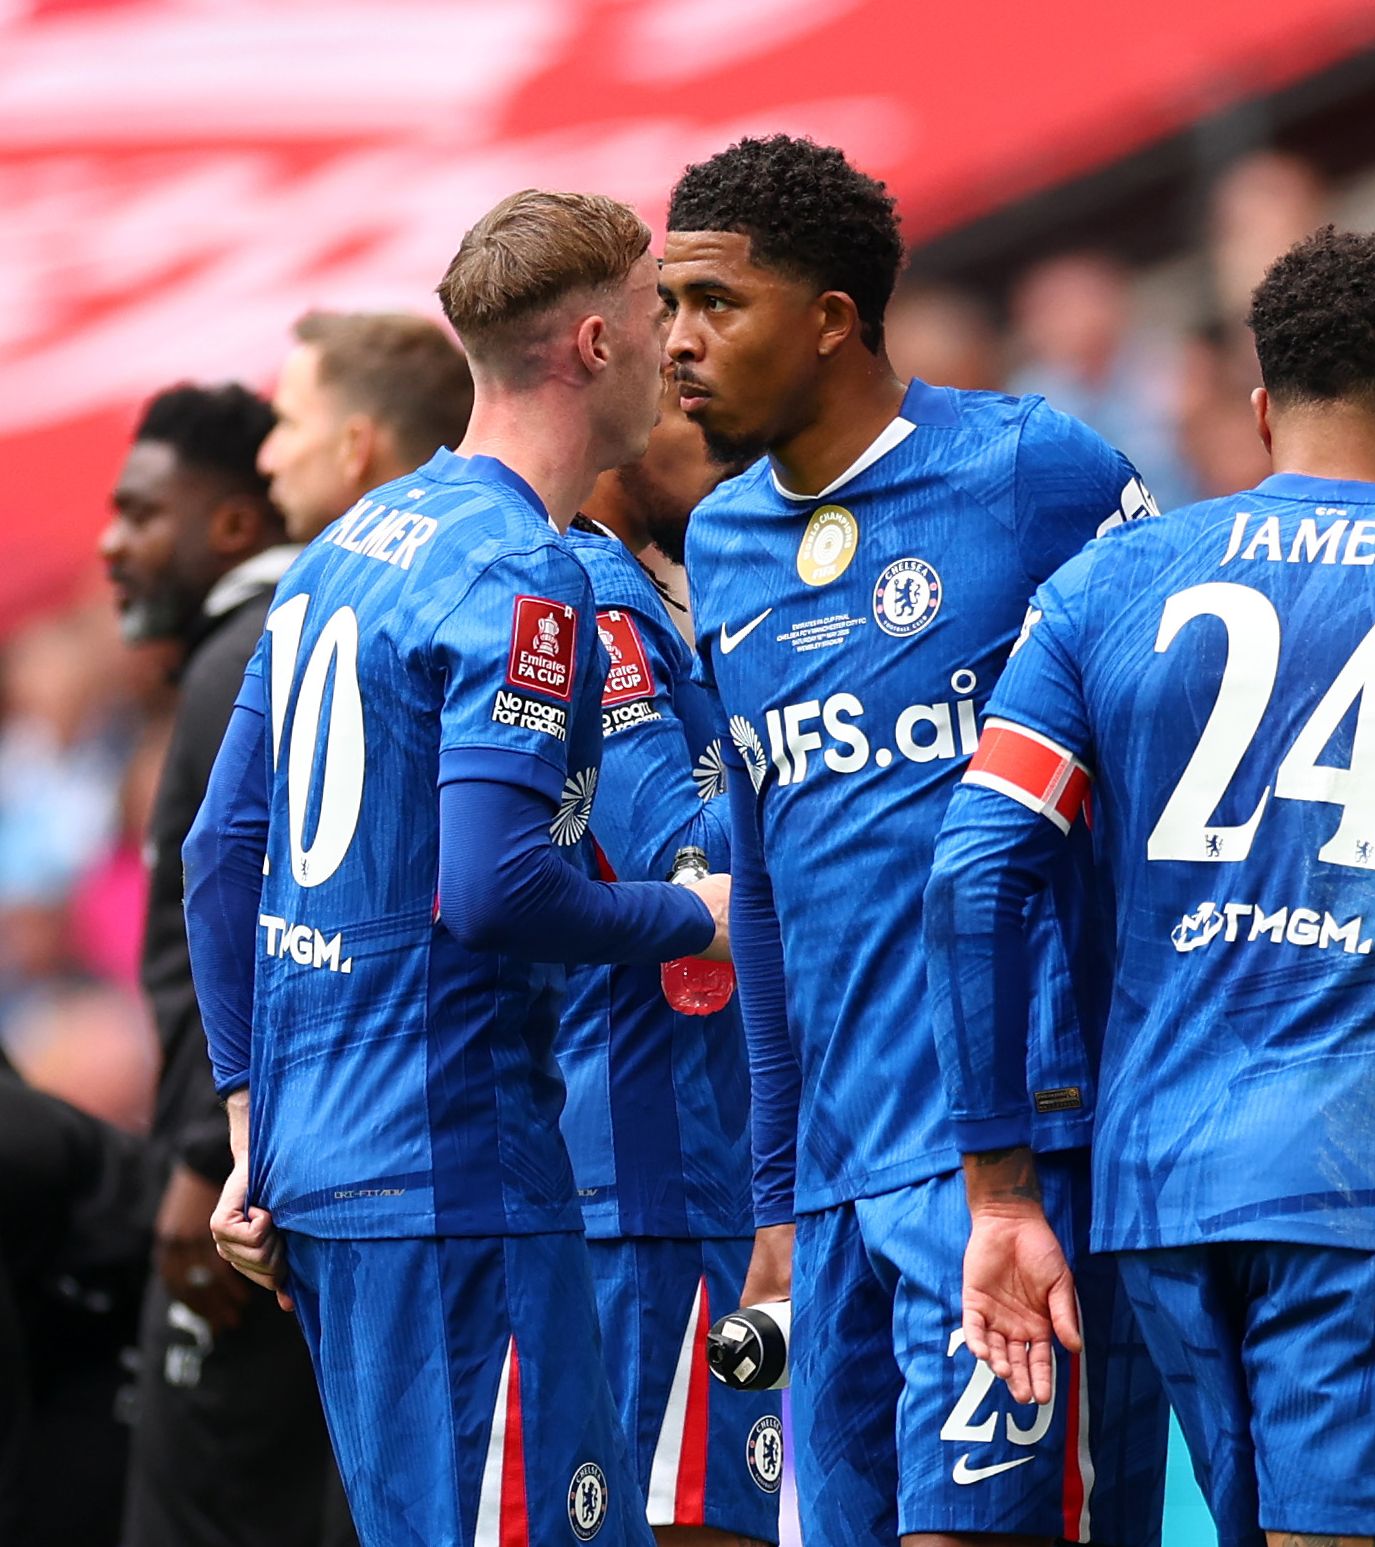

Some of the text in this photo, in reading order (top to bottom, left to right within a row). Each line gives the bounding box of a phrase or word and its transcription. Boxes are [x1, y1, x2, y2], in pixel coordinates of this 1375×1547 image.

[322, 498, 438, 571] ALMER
[885, 561, 929, 580] CHELSEA
[518, 663, 565, 687] FA CUP
[520, 651, 566, 674] Emirates
[611, 674, 642, 691] CUP
[491, 706, 566, 742] for racism
[495, 690, 566, 726] No room
[262, 593, 366, 888] 10
[766, 669, 979, 787] IFS.ai
